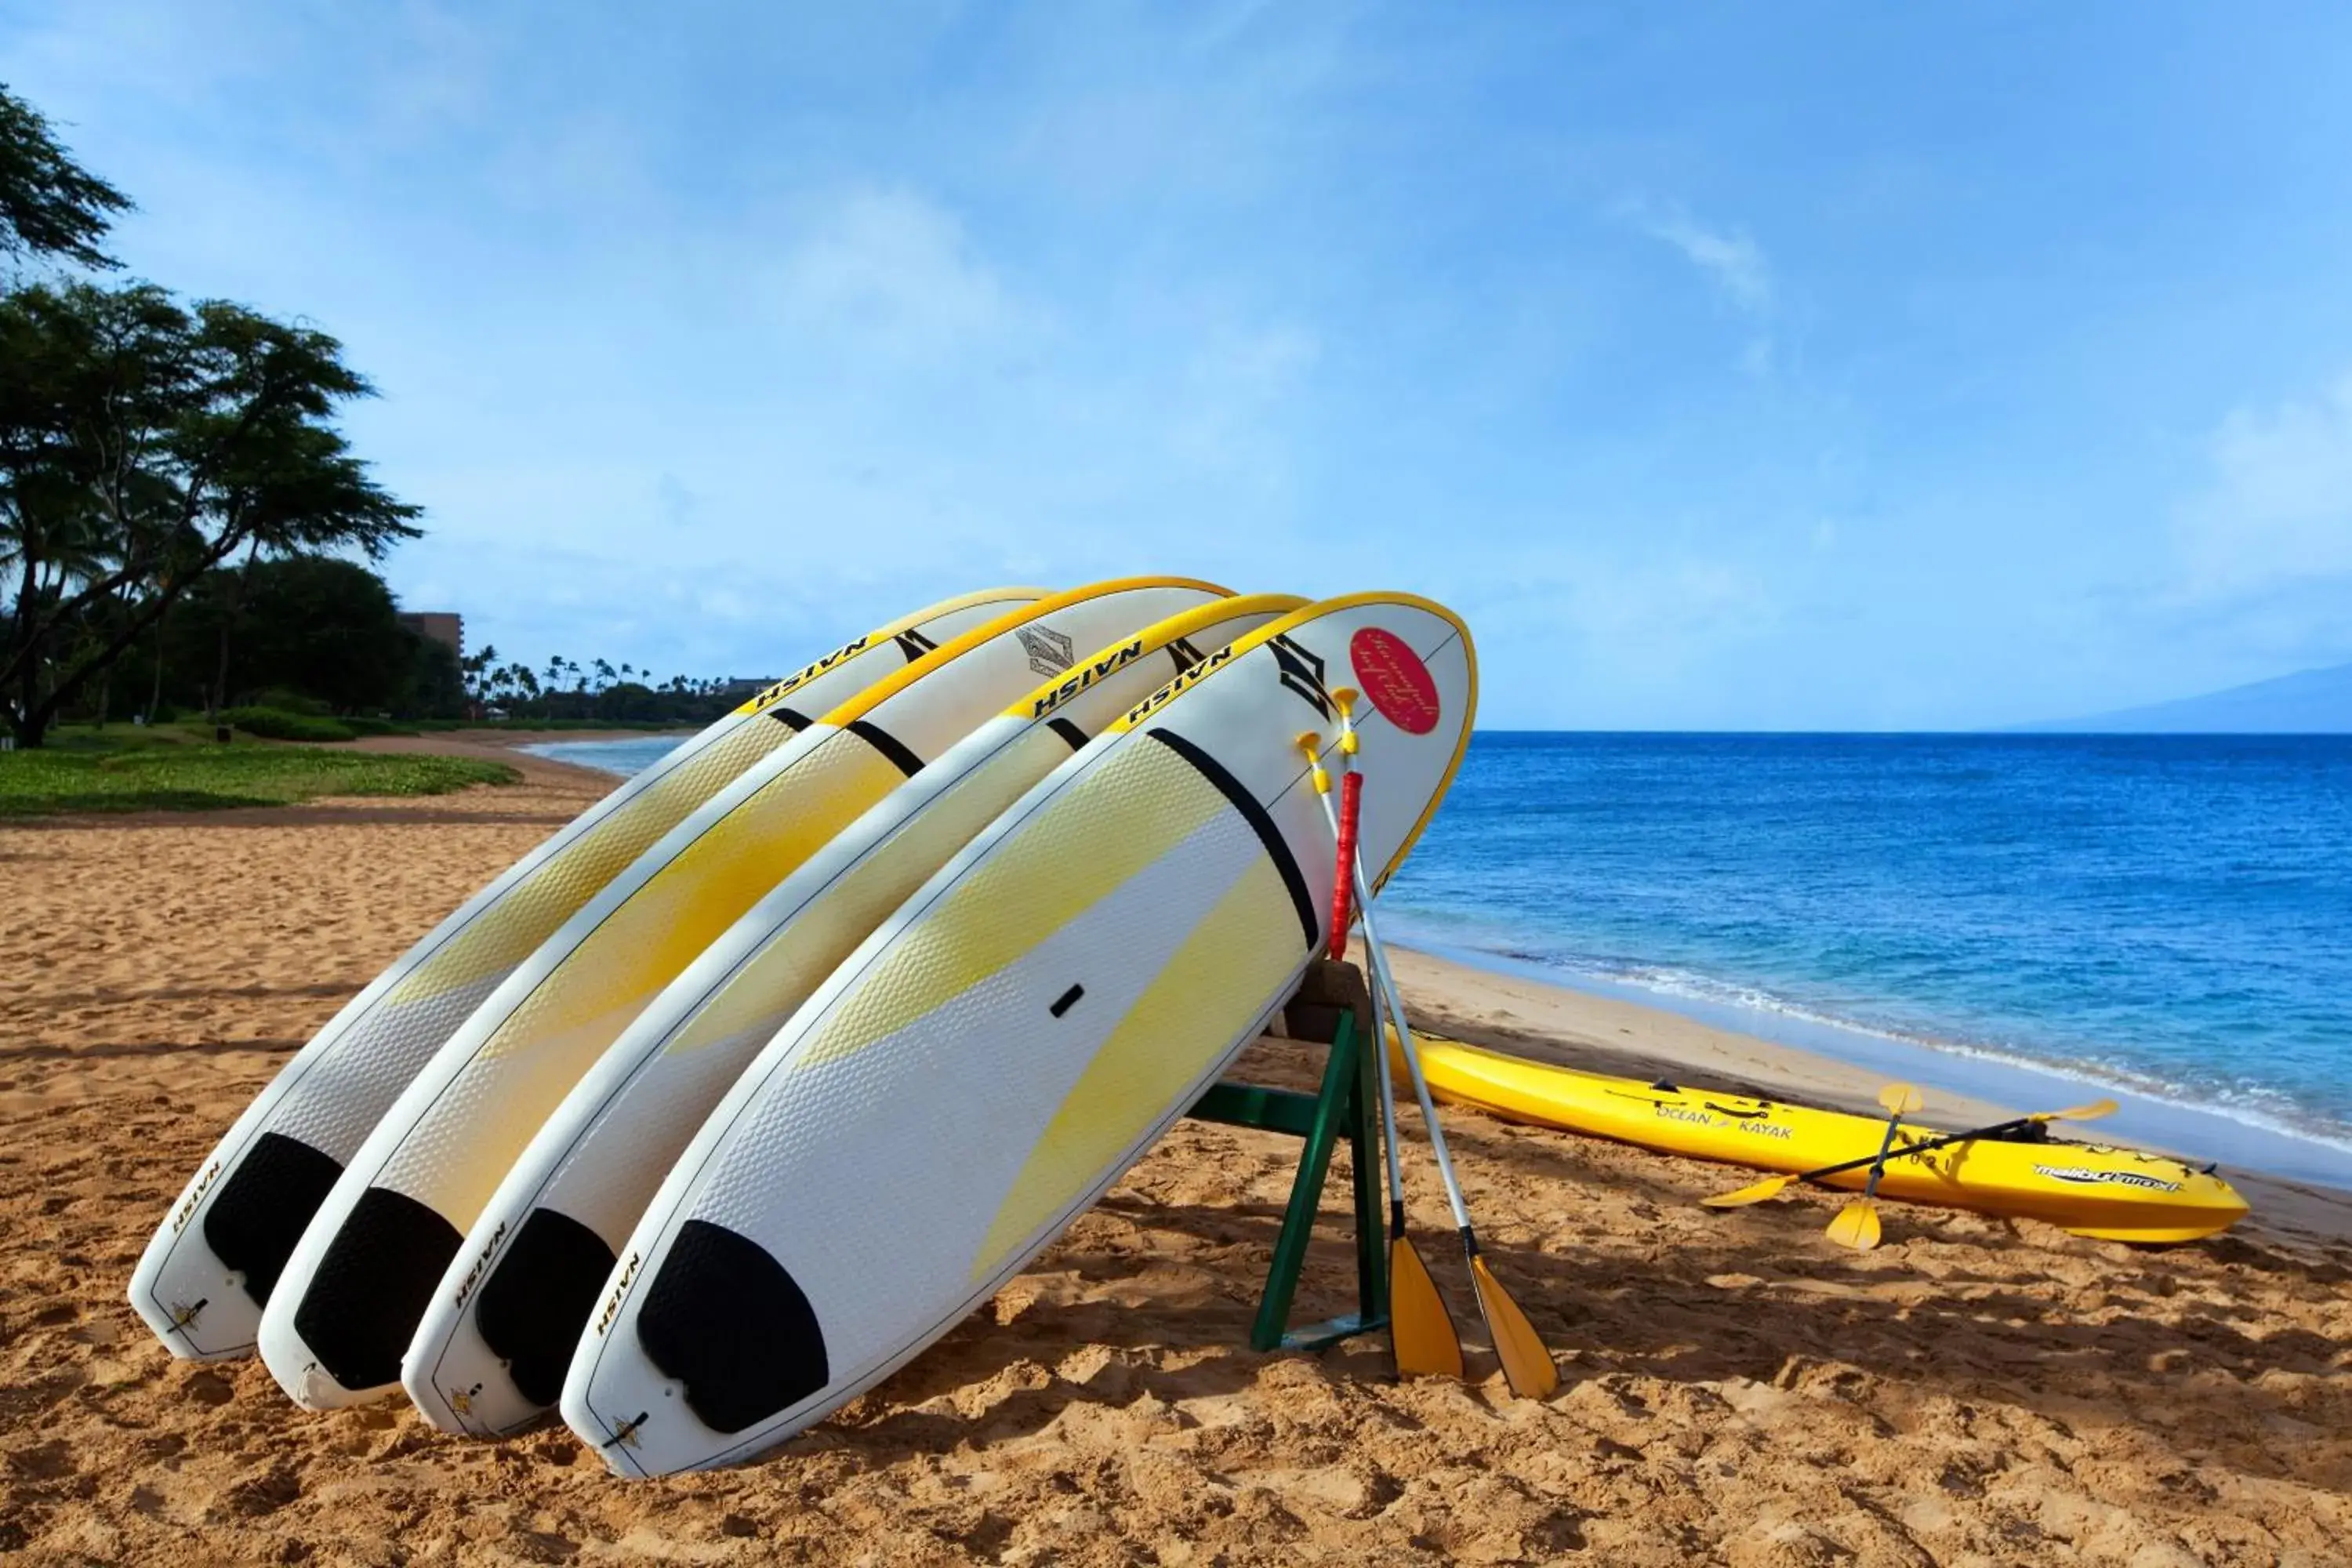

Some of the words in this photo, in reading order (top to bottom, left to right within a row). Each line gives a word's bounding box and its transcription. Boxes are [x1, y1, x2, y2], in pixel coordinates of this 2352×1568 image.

[755, 636, 869, 708] NAISH
[1033, 640, 1143, 719] NAISH
[1129, 645, 1232, 724] NAISH
[1657, 1106, 1712, 1125] OCEAN
[1739, 1120, 1793, 1139] KAYAK
[456, 1221, 506, 1310] NAISH
[596, 1251, 641, 1338] NAISH
